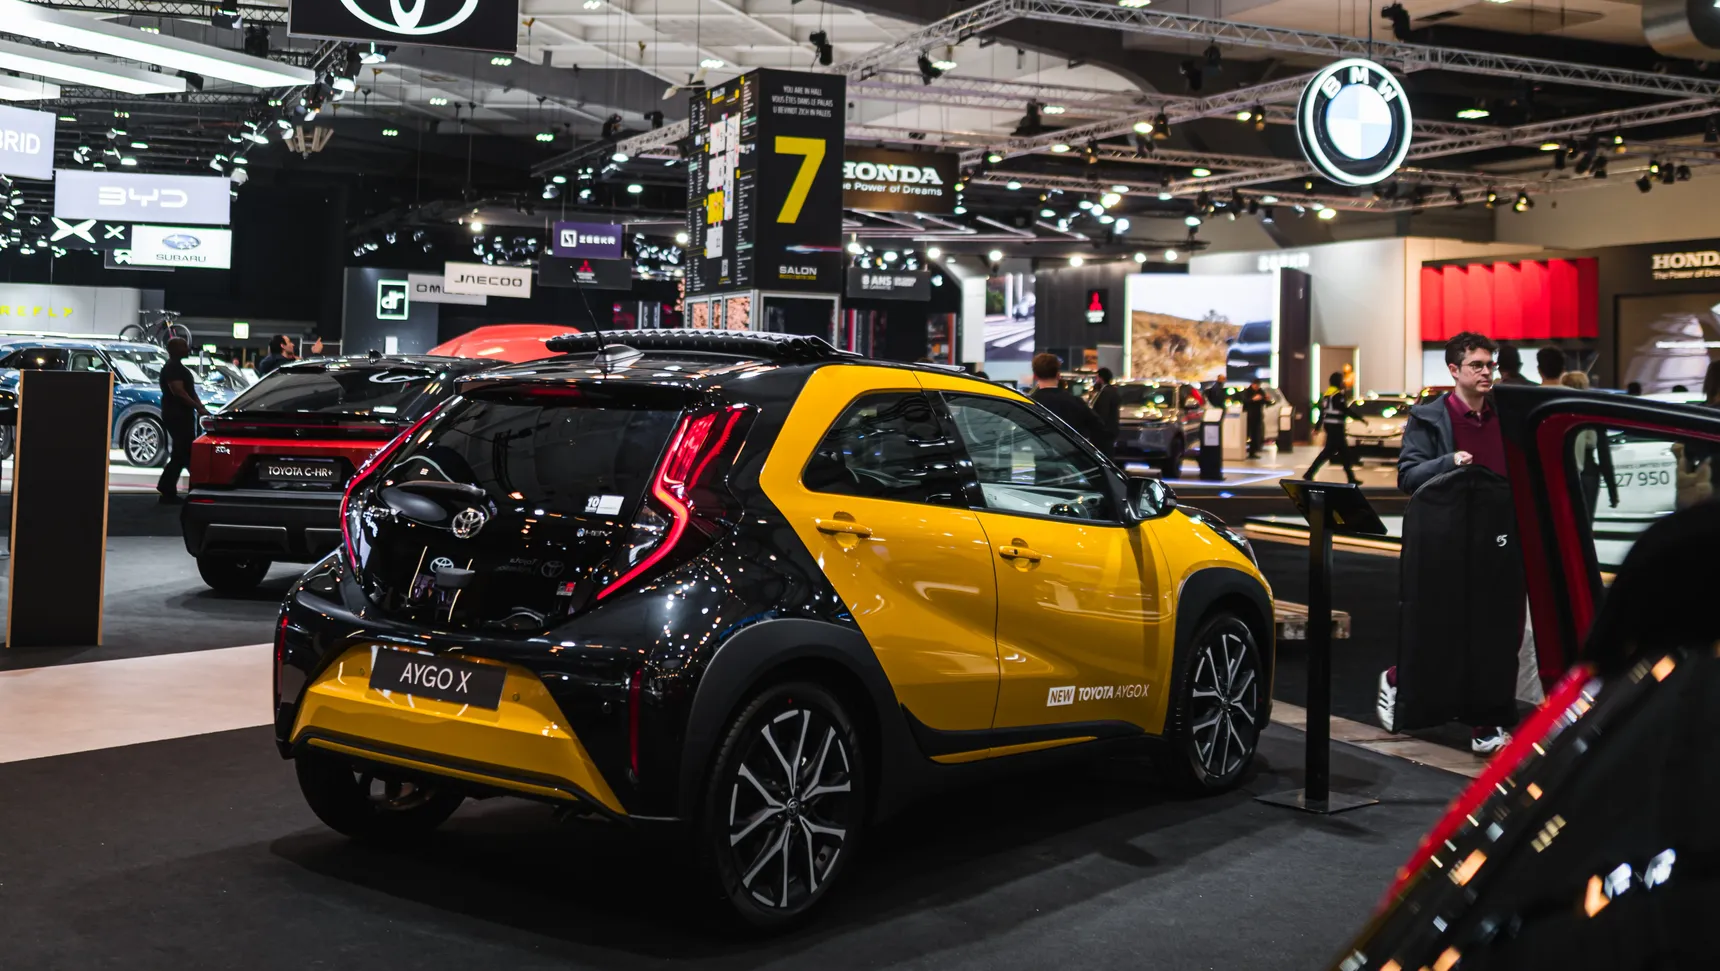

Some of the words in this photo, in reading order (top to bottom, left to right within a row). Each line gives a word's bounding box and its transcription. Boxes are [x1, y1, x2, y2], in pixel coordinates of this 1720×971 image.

[1321, 66, 1399, 103] BMW
[0, 129, 41, 155] RID
[774, 135, 827, 224] 7
[98, 186, 189, 208] BYD
[854, 182, 887, 192] Power
[889, 184, 900, 193] of
[902, 185, 943, 196] Dreams
[155, 253, 207, 263] SUBARU
[1652, 250, 1720, 270] HOND
[779, 266, 818, 276] SALON
[454, 274, 523, 288] JAECOO
[268, 466, 303, 477] TOYOTA
[304, 467, 333, 477] C-HR+
[1637, 470, 1670, 487] 950
[587, 496, 600, 508] 10
[400, 662, 454, 690] AYGO
[455, 670, 473, 694] X
[1049, 688, 1074, 705] NEW
[1078, 686, 1114, 701] TOYOTA
[1114, 684, 1142, 699] AYGO
[1142, 683, 1150, 697] X
